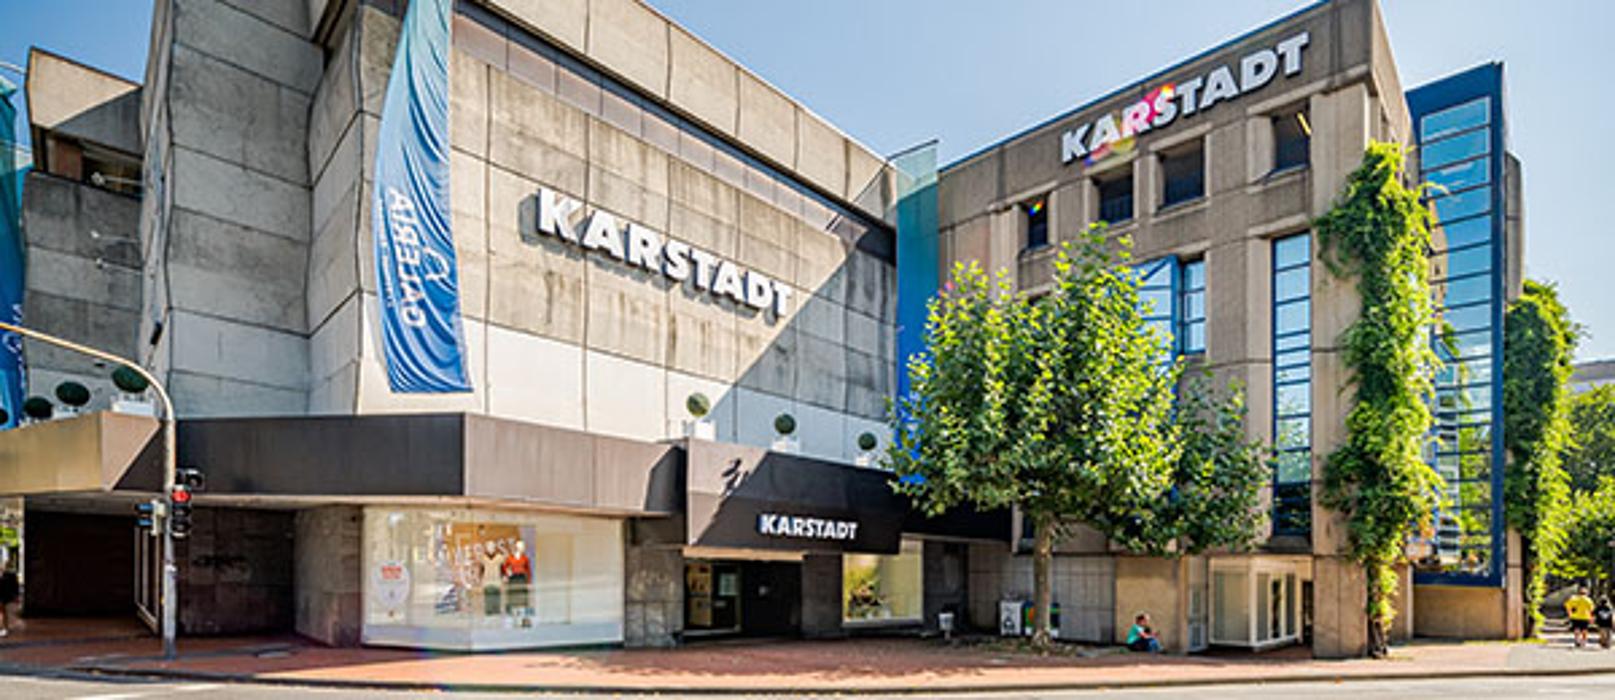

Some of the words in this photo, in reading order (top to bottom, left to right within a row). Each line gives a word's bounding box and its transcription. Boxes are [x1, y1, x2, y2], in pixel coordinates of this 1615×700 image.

[1061, 32, 1309, 163] KARSTADT
[537, 187, 793, 317] KARSTADT
[759, 513, 859, 540] KARSTADT
